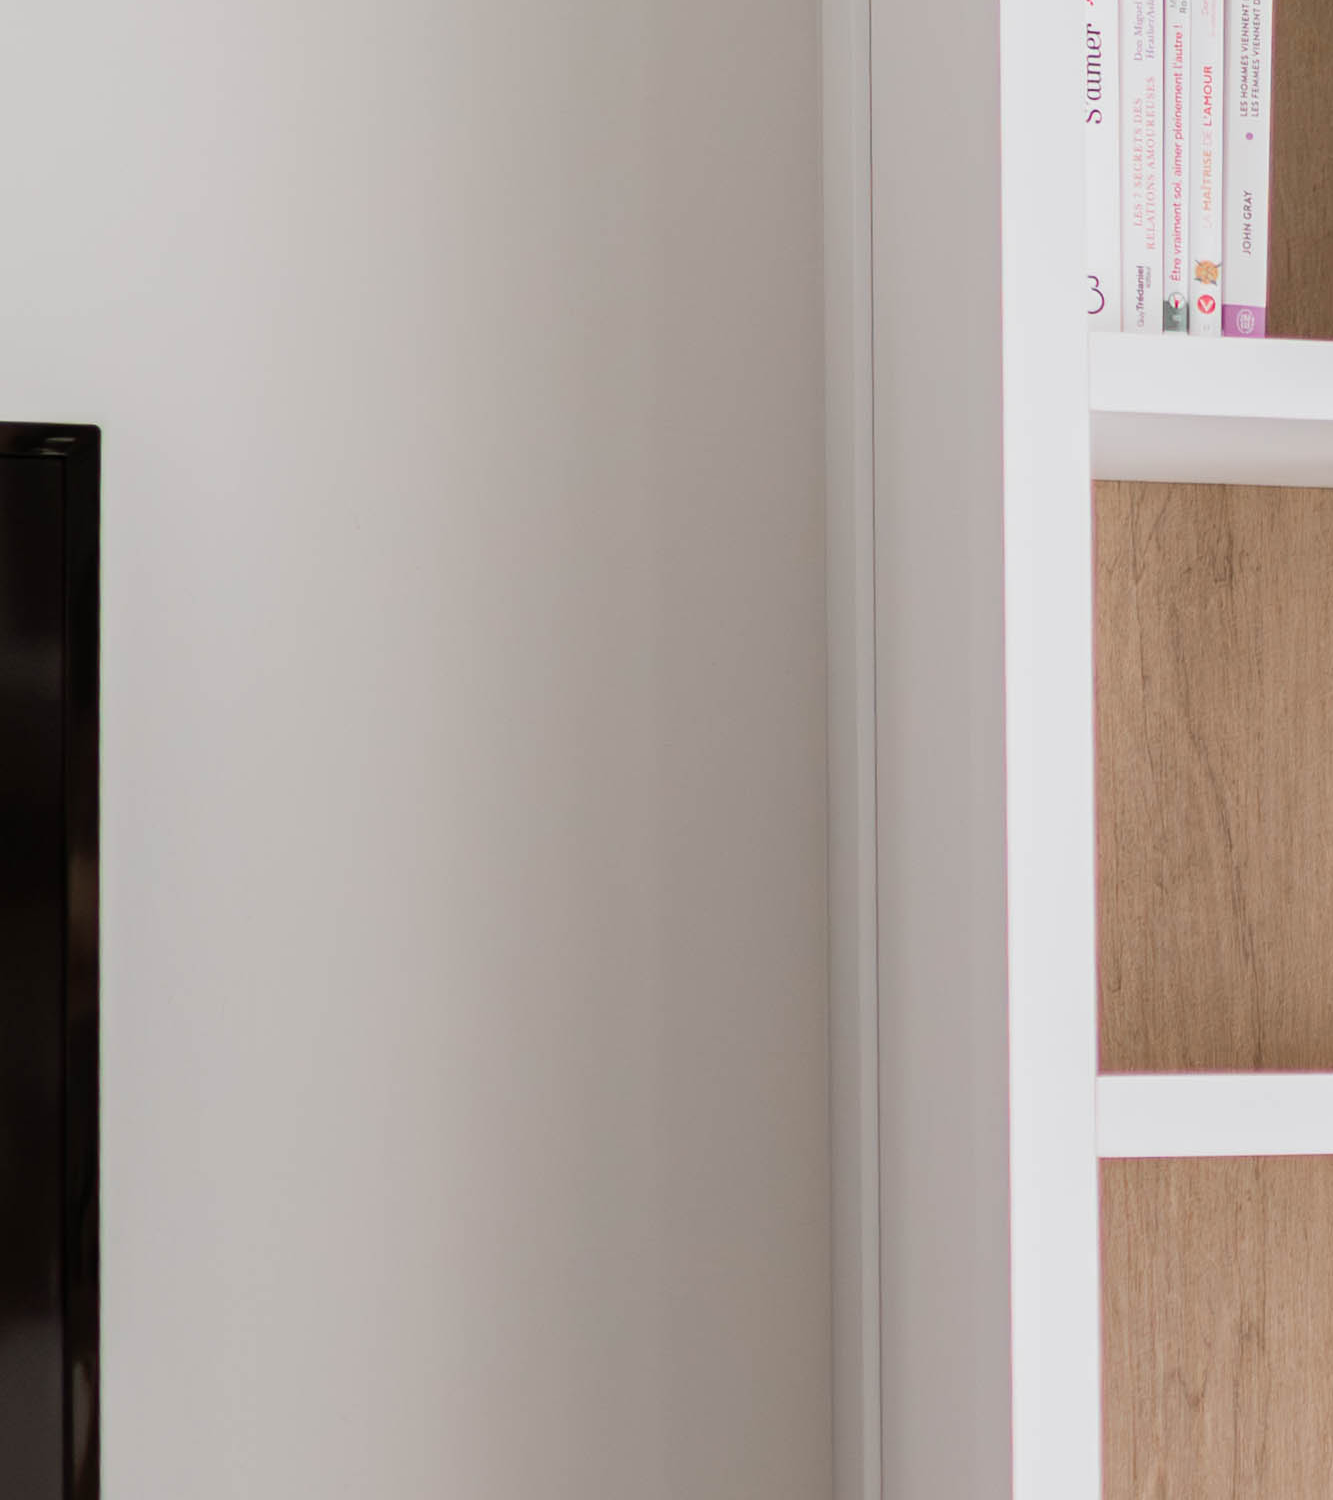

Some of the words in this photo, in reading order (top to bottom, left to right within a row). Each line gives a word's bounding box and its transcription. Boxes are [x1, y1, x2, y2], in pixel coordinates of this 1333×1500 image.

[1241, 3, 1250, 52] VIENNENT
[1252, 8, 1262, 57] VIENNENT
[1202, 65, 1212, 127] L'AMOUR
[1240, 54, 1249, 97] HOMMES
[1251, 59, 1261, 99] FEMMES
[1131, 97, 1143, 124] DES
[1170, 72, 1184, 140] pleinement
[1240, 99, 1249, 117] LES
[1251, 101, 1260, 117] LES
[1132, 127, 1143, 188] SECRETS
[1132, 203, 1143, 227] LES
[1145, 175, 1156, 250] RELATIONS
[1241, 189, 1252, 220] GRAY
[1170, 202, 1182, 255] vraiment
[1241, 222, 1252, 256] JOHN
